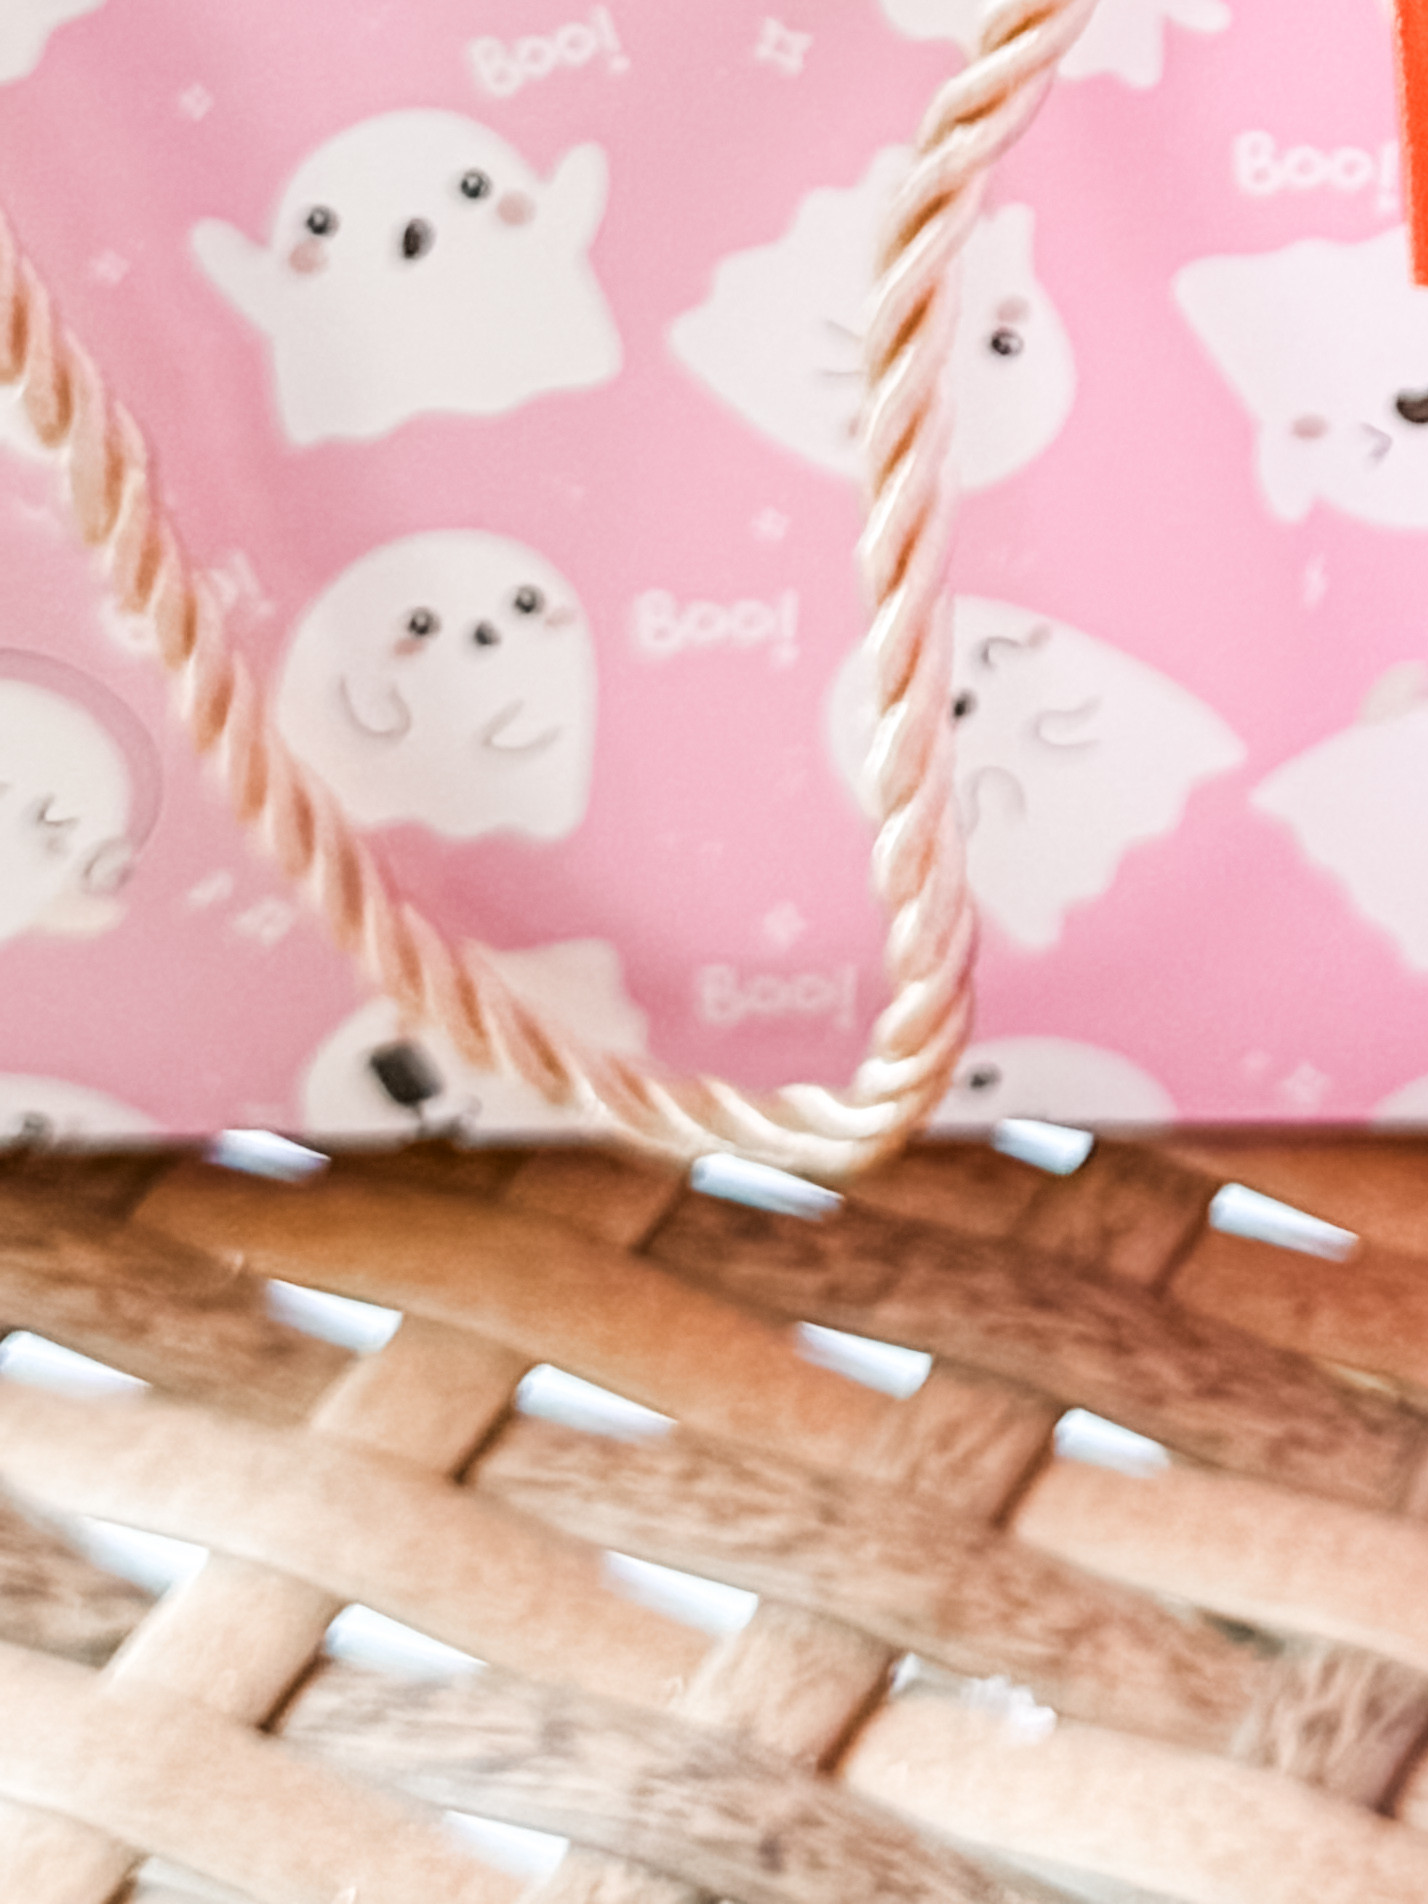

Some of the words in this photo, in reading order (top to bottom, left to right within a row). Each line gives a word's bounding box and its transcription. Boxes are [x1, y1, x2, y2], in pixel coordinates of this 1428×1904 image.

[470, 4, 630, 96] Boo!
[1234, 130, 1400, 210] Boo!
[634, 588, 796, 664] Boo!
[694, 964, 856, 1032] Boo!
